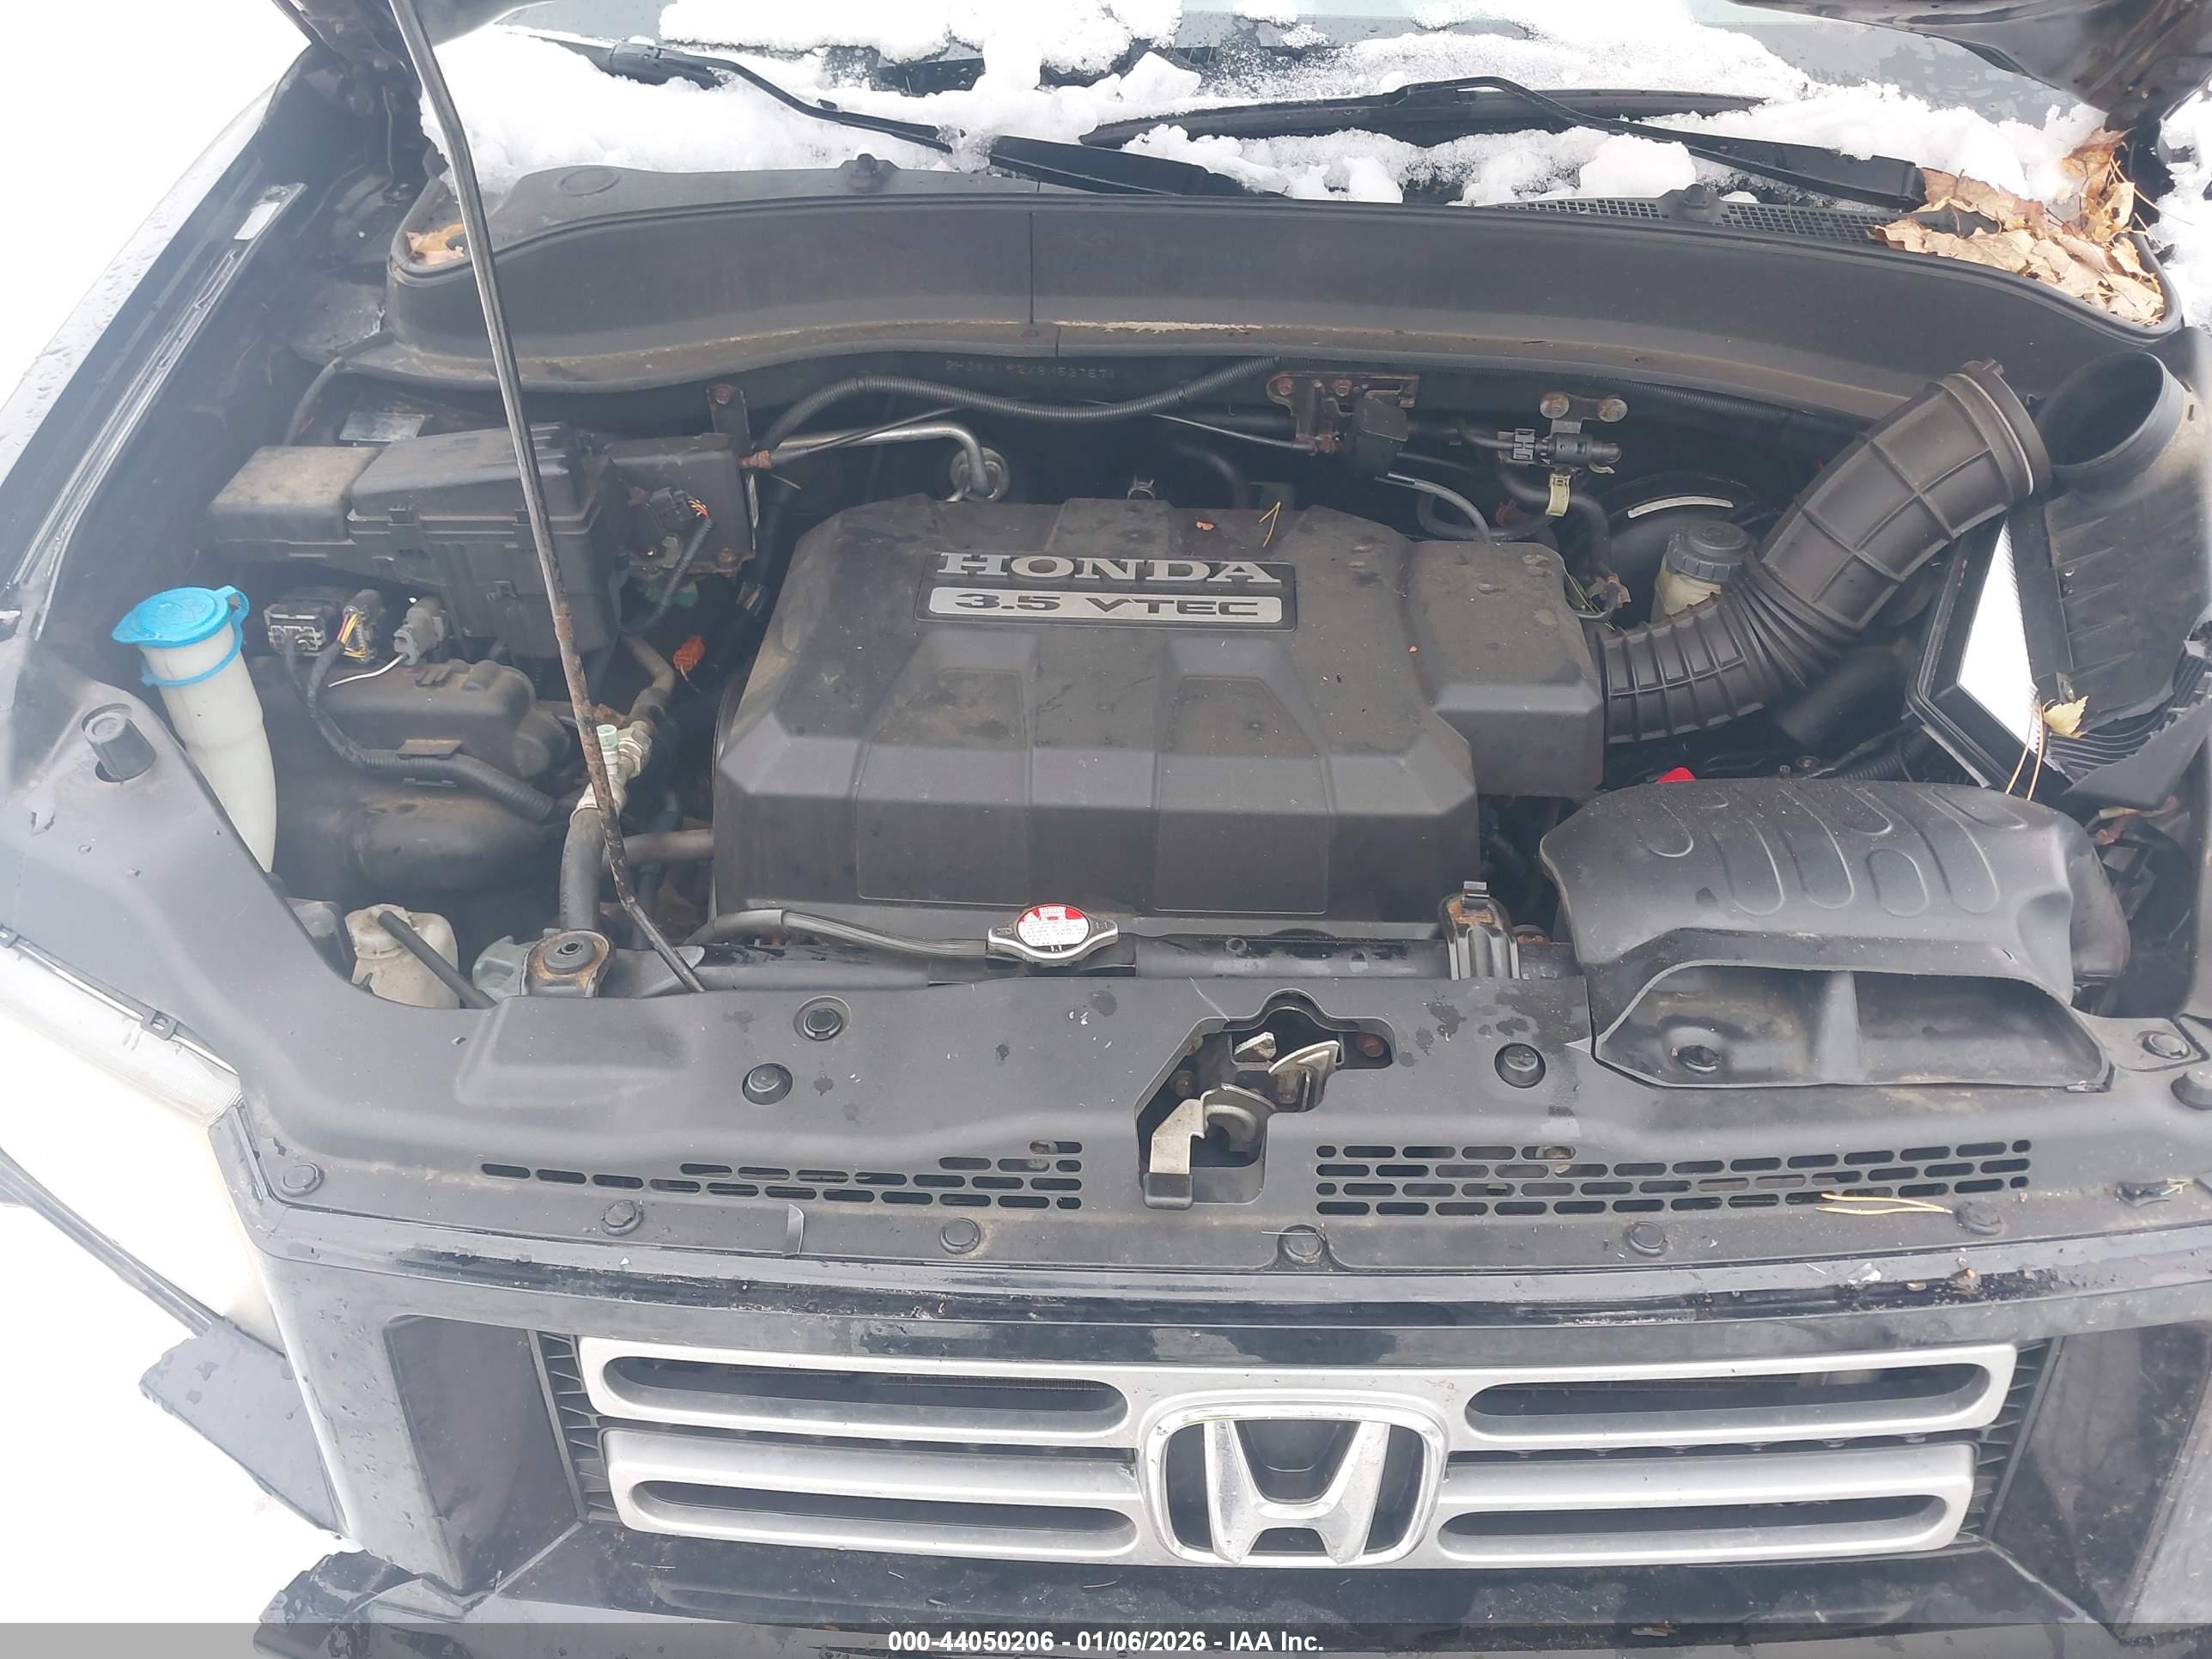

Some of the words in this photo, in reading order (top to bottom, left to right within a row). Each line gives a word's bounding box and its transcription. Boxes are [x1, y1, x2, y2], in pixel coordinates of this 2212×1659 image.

[938, 552, 1283, 585] HONDA
[954, 592, 1061, 612] 3.5
[1085, 597, 1259, 617] VTEC
